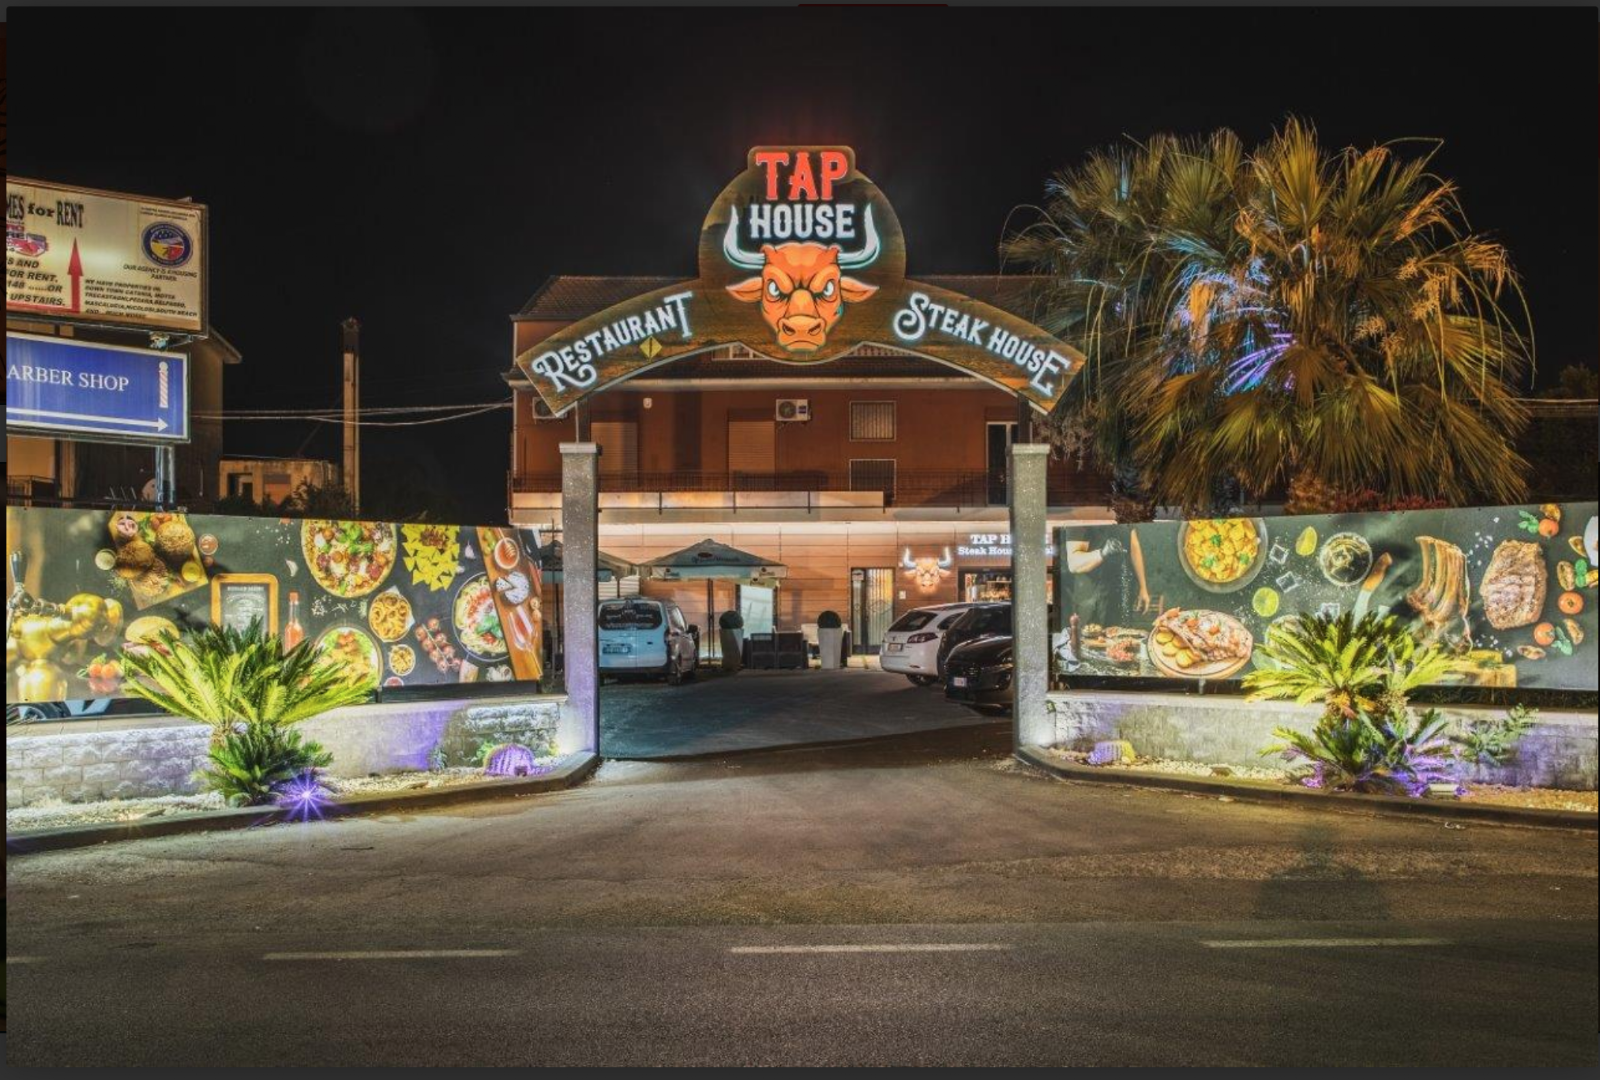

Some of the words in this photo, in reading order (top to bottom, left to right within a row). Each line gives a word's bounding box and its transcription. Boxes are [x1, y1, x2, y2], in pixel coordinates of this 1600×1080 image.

[755, 151, 848, 201] TAP
[27, 202, 55, 217] for
[56, 200, 84, 228] RENT
[749, 203, 856, 239] HOUSE
[15, 259, 40, 269] AND
[27, 271, 58, 283] RENT.
[10, 293, 66, 306] UPSTAIRS.
[532, 291, 693, 392] RESTAURANT
[894, 291, 990, 345] STEAK
[987, 326, 1071, 397] HOUSE
[7, 364, 74, 386] ARBER
[78, 372, 129, 392] SHOP
[958, 546, 987, 556] Steak
[970, 534, 997, 545] TAP
